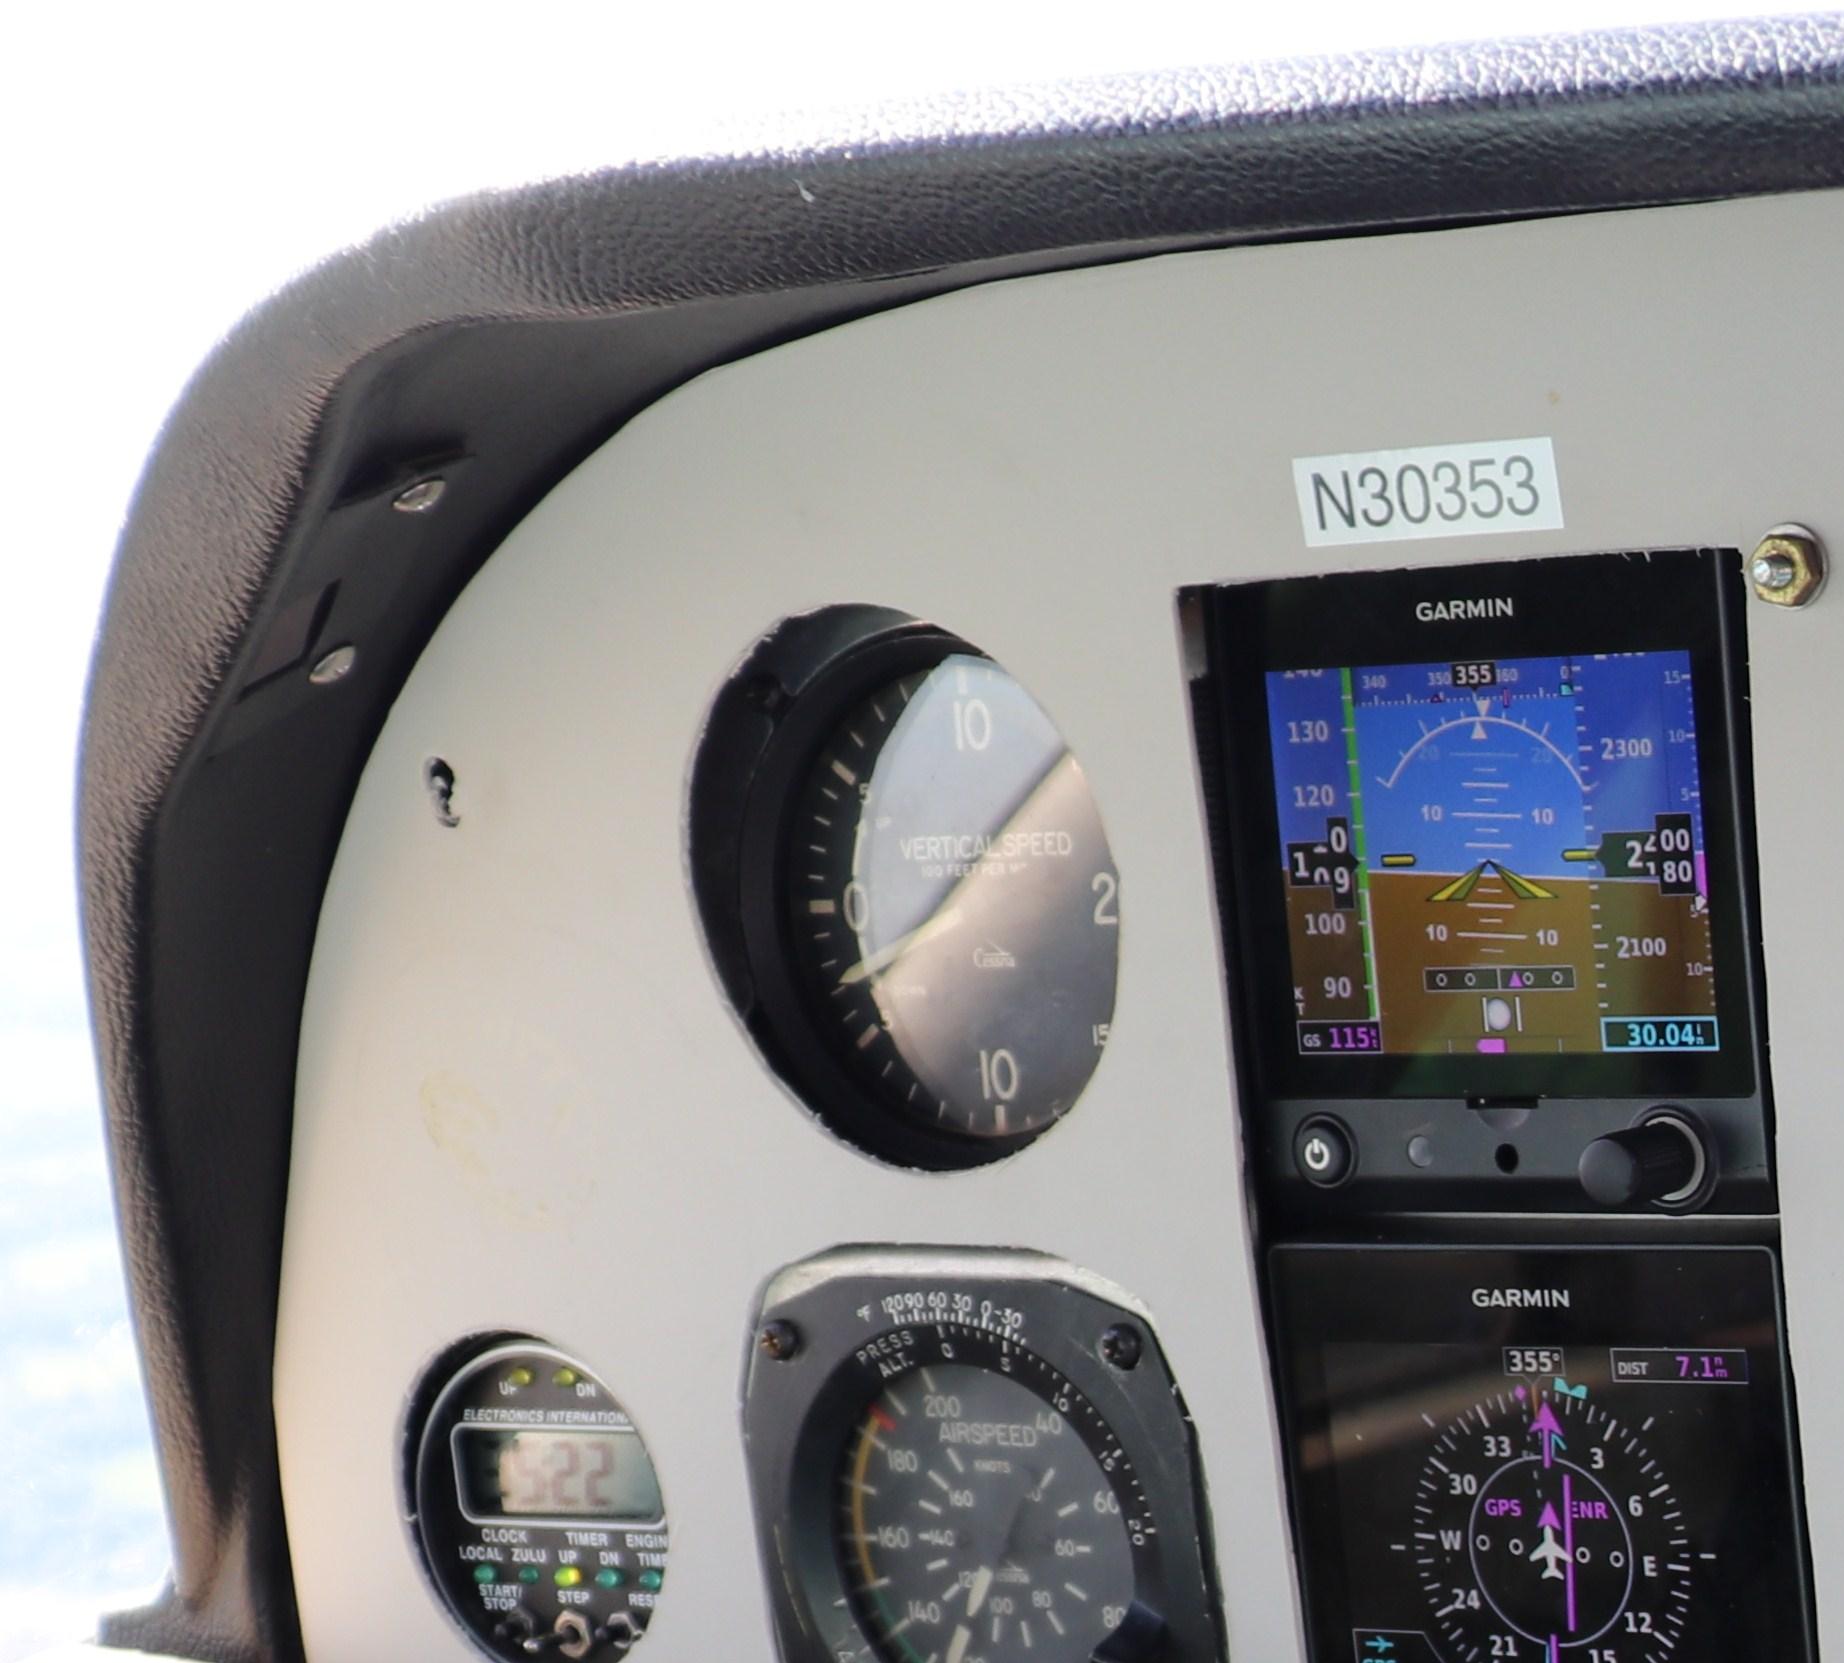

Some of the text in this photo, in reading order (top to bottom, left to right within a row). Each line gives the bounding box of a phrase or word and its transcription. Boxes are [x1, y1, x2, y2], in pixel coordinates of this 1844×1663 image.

[1310, 455, 1541, 530] N30353
[1416, 598, 1514, 622] GARMIN
[1455, 662, 1492, 686] 355
[1601, 738, 1652, 761] 2300
[900, 831, 1072, 859] VERTICAL SPEED
[978, 1049, 1017, 1100] 10
[1472, 1288, 1570, 1307] GARMIN
[1618, 1361, 1648, 1376] DIST
[464, 1409, 545, 1424] ELECTRONICS
[938, 1421, 1037, 1448] AIRSPEED
[1485, 1498, 1522, 1517] GPS
[481, 1529, 527, 1545] CLOCK
[566, 1531, 608, 1547] TIMER
[458, 1547, 502, 1562] LOCAL
[511, 1548, 546, 1563] ZULU
